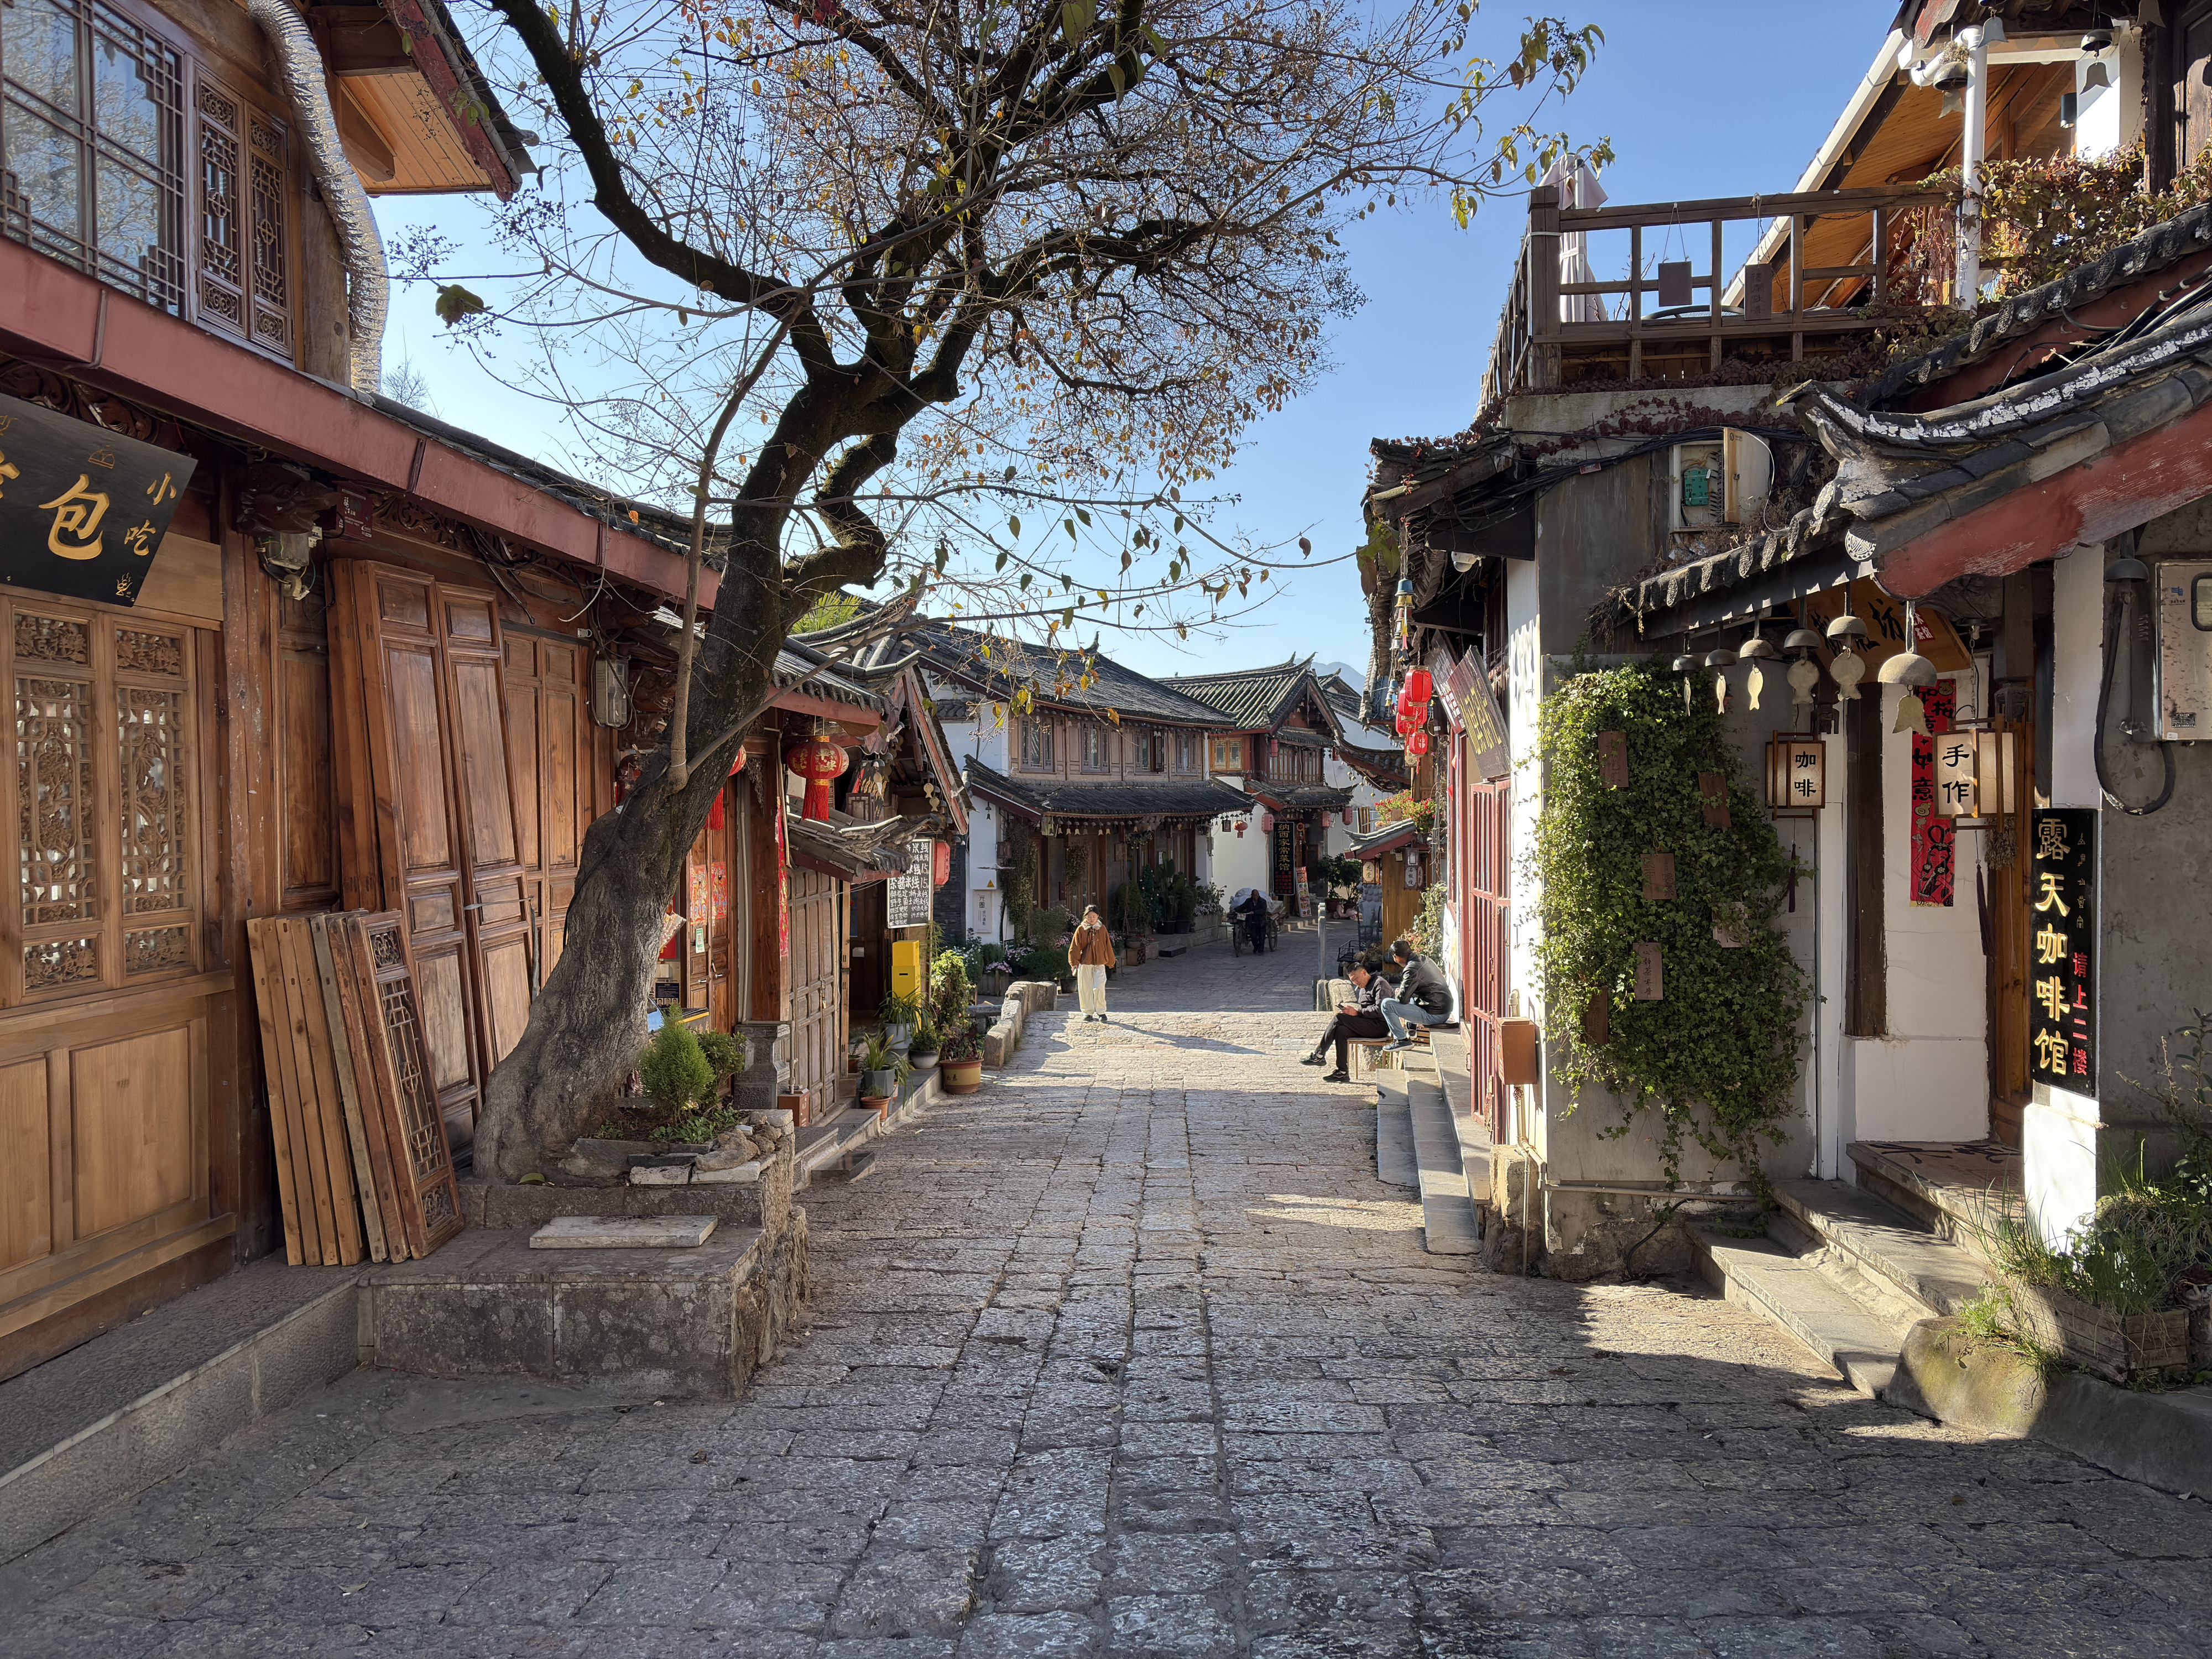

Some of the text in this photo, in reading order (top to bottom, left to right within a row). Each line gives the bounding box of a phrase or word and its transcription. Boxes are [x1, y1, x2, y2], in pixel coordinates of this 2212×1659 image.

[124, 472, 177, 556] 小吃
[1795, 751, 1816, 798] 咖啡
[1942, 744, 1970, 804] 手作
[1277, 823, 1291, 871] 纳西家常菜馆
[979, 895, 985, 909] 光圈
[2034, 818, 2070, 1076] 露天咖啡馆
[2073, 952, 2089, 1076] 请上二楼
